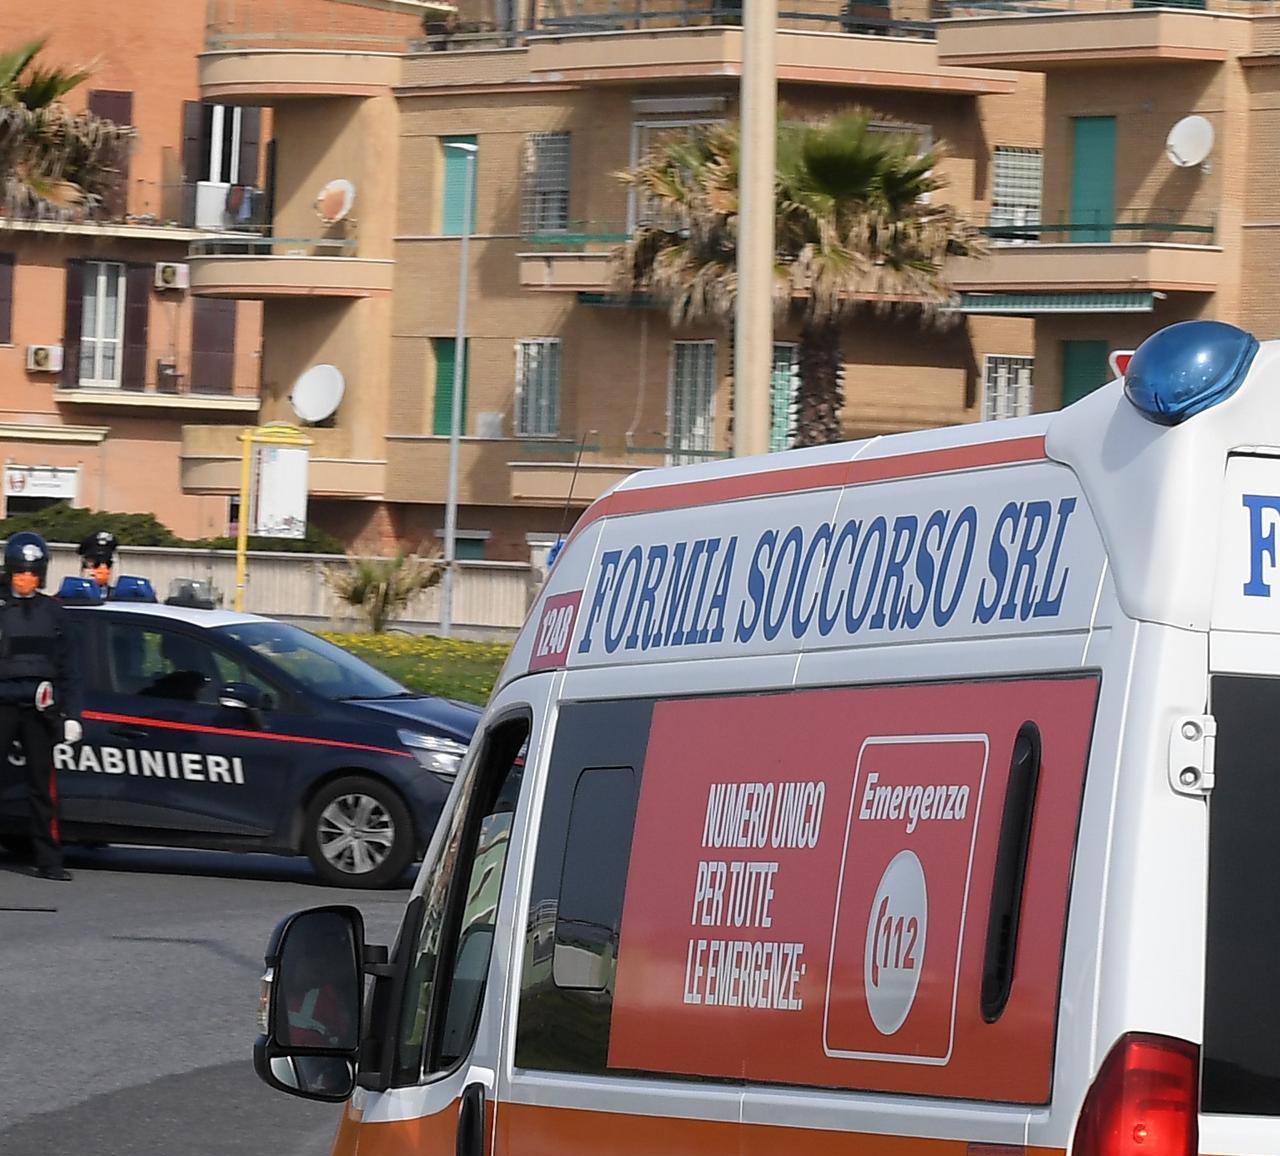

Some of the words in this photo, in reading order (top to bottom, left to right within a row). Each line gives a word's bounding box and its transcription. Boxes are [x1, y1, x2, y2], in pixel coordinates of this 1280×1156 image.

[578, 535, 739, 654] FORMIA
[734, 505, 977, 644] SOCCORSO
[972, 497, 1078, 625] SRL
[537, 604, 574, 657] 1248
[701, 782, 775, 849] NUMERO
[771, 781, 826, 849] UNICO
[858, 772, 970, 834] Emergenza
[691, 861, 727, 926] PER
[726, 862, 779, 928] TUTTE
[683, 938, 707, 1005] LE
[882, 915, 919, 970] 112
